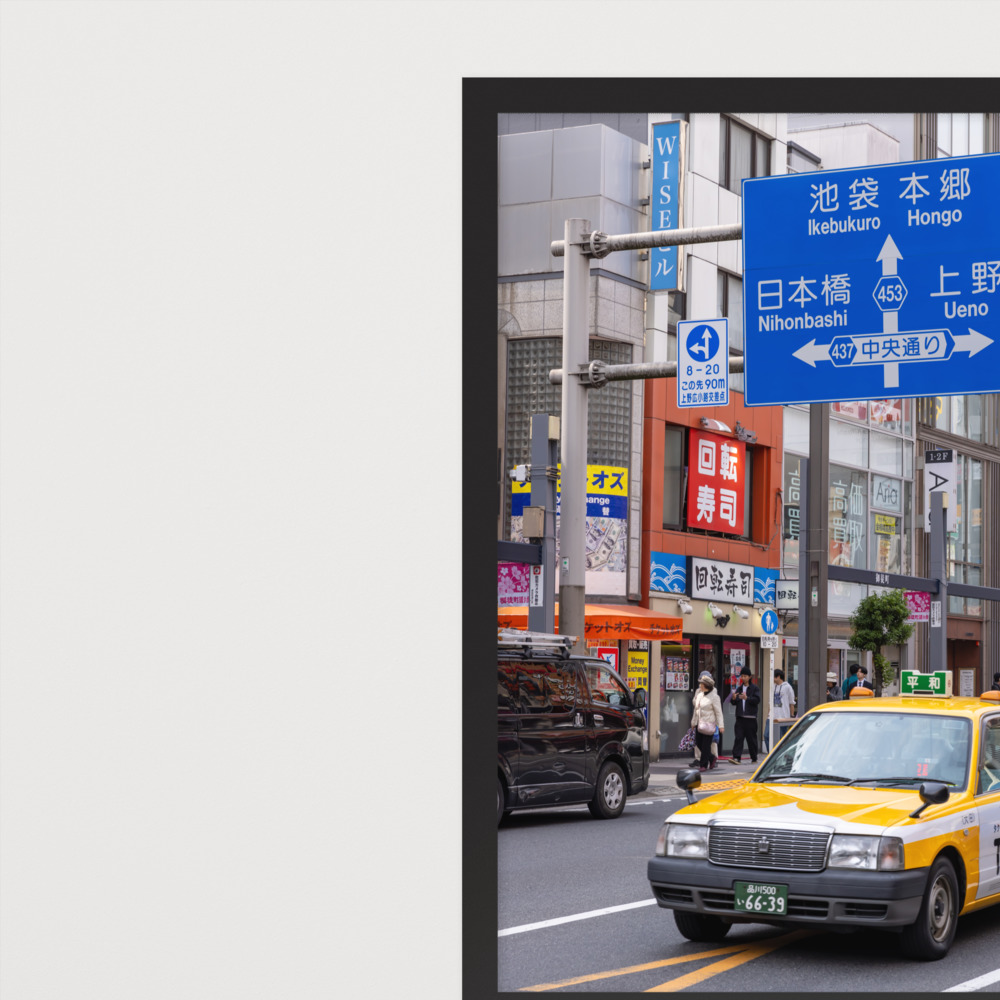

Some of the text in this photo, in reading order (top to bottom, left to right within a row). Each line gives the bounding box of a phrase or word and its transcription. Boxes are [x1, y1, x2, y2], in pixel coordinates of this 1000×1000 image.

[809, 168, 971, 214] 池袋 本郷
[808, 208, 963, 236] Ikebukuro Hongo
[758, 273, 851, 311] 日本橋
[877, 285, 903, 303] 453
[944, 301, 989, 319] Ueno
[758, 310, 849, 332] Nihonbashi
[831, 343, 854, 360] 437
[861, 336, 941, 360] 中央通り
[698, 438, 738, 483] 回転
[696, 484, 738, 528] 寿司
[695, 564, 751, 598] 回転寿司
[777, 590, 799, 600] 回転
[585, 621, 631, 633] ケットオズ
[628, 665, 648, 674] Exchange
[631, 656, 645, 665] Money
[906, 676, 941, 689] 平和
